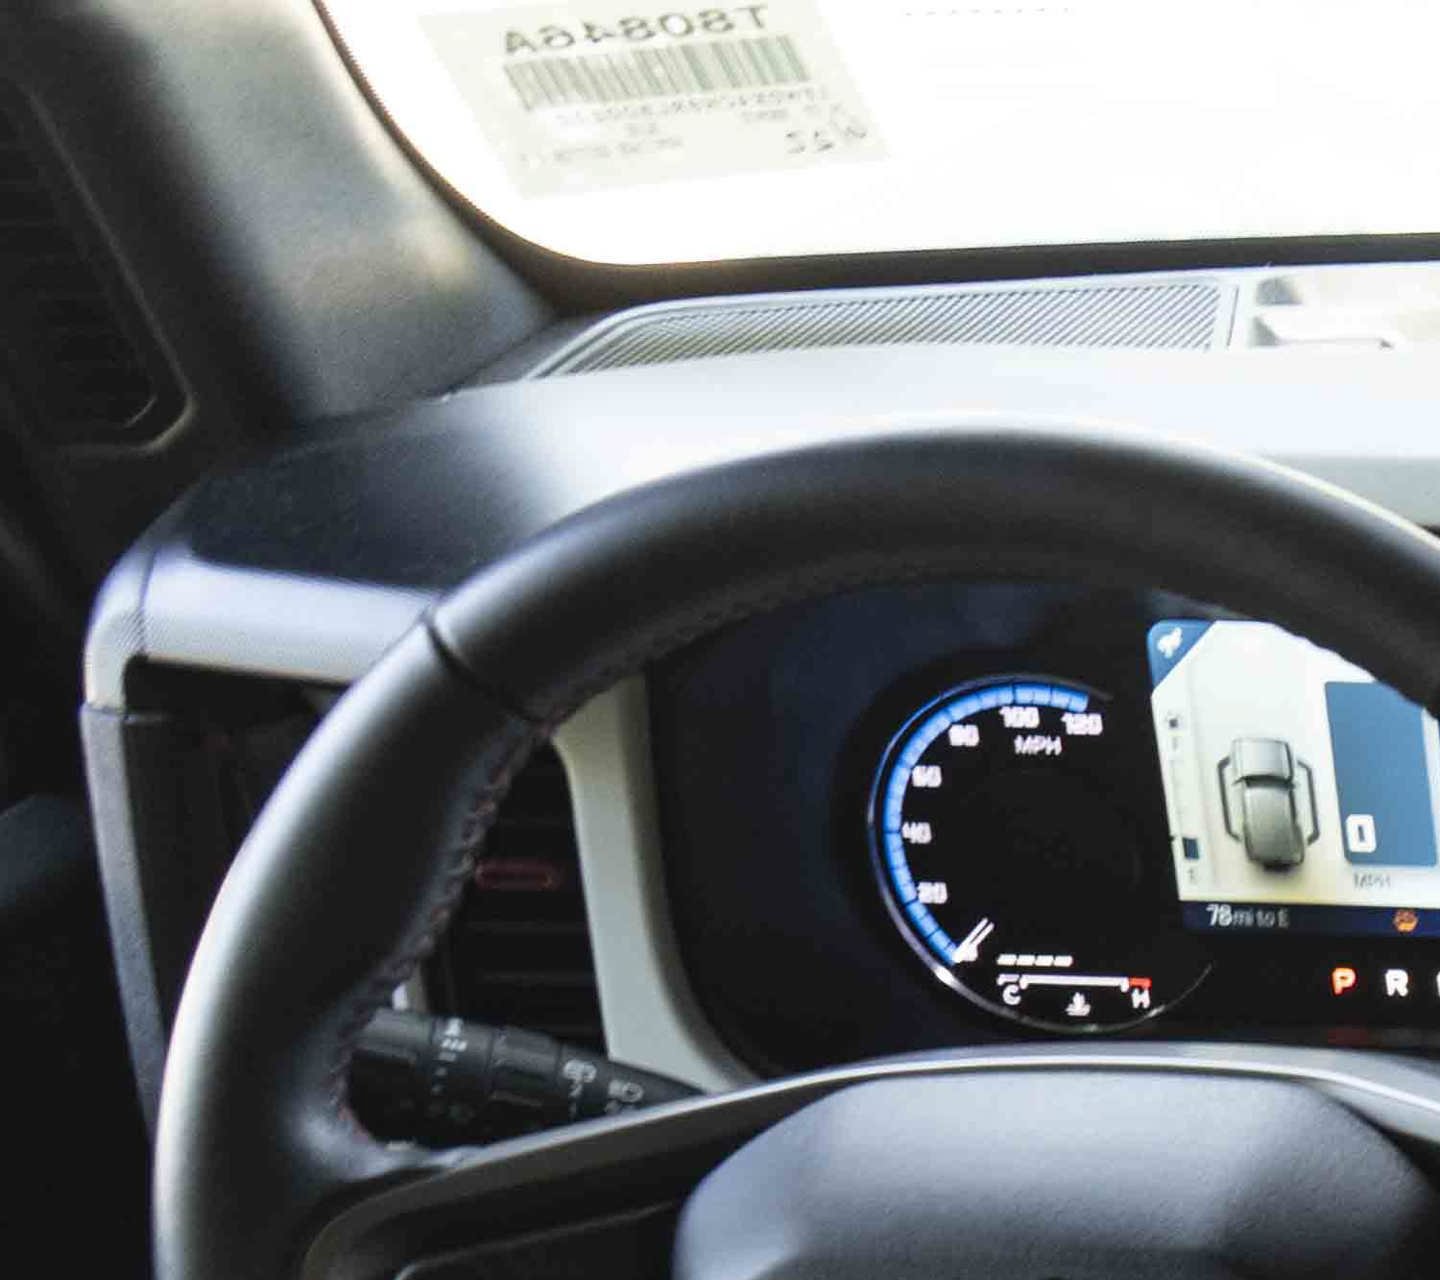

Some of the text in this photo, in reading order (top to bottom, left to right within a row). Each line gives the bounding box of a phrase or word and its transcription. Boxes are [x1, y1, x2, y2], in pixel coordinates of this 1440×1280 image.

[1014, 735, 1062, 755] MPH
[1346, 814, 1376, 853] 0
[1332, 967, 1356, 994] P
[1385, 969, 1408, 996] R
[1002, 984, 1021, 1005] C
[1131, 988, 1150, 1008] H
